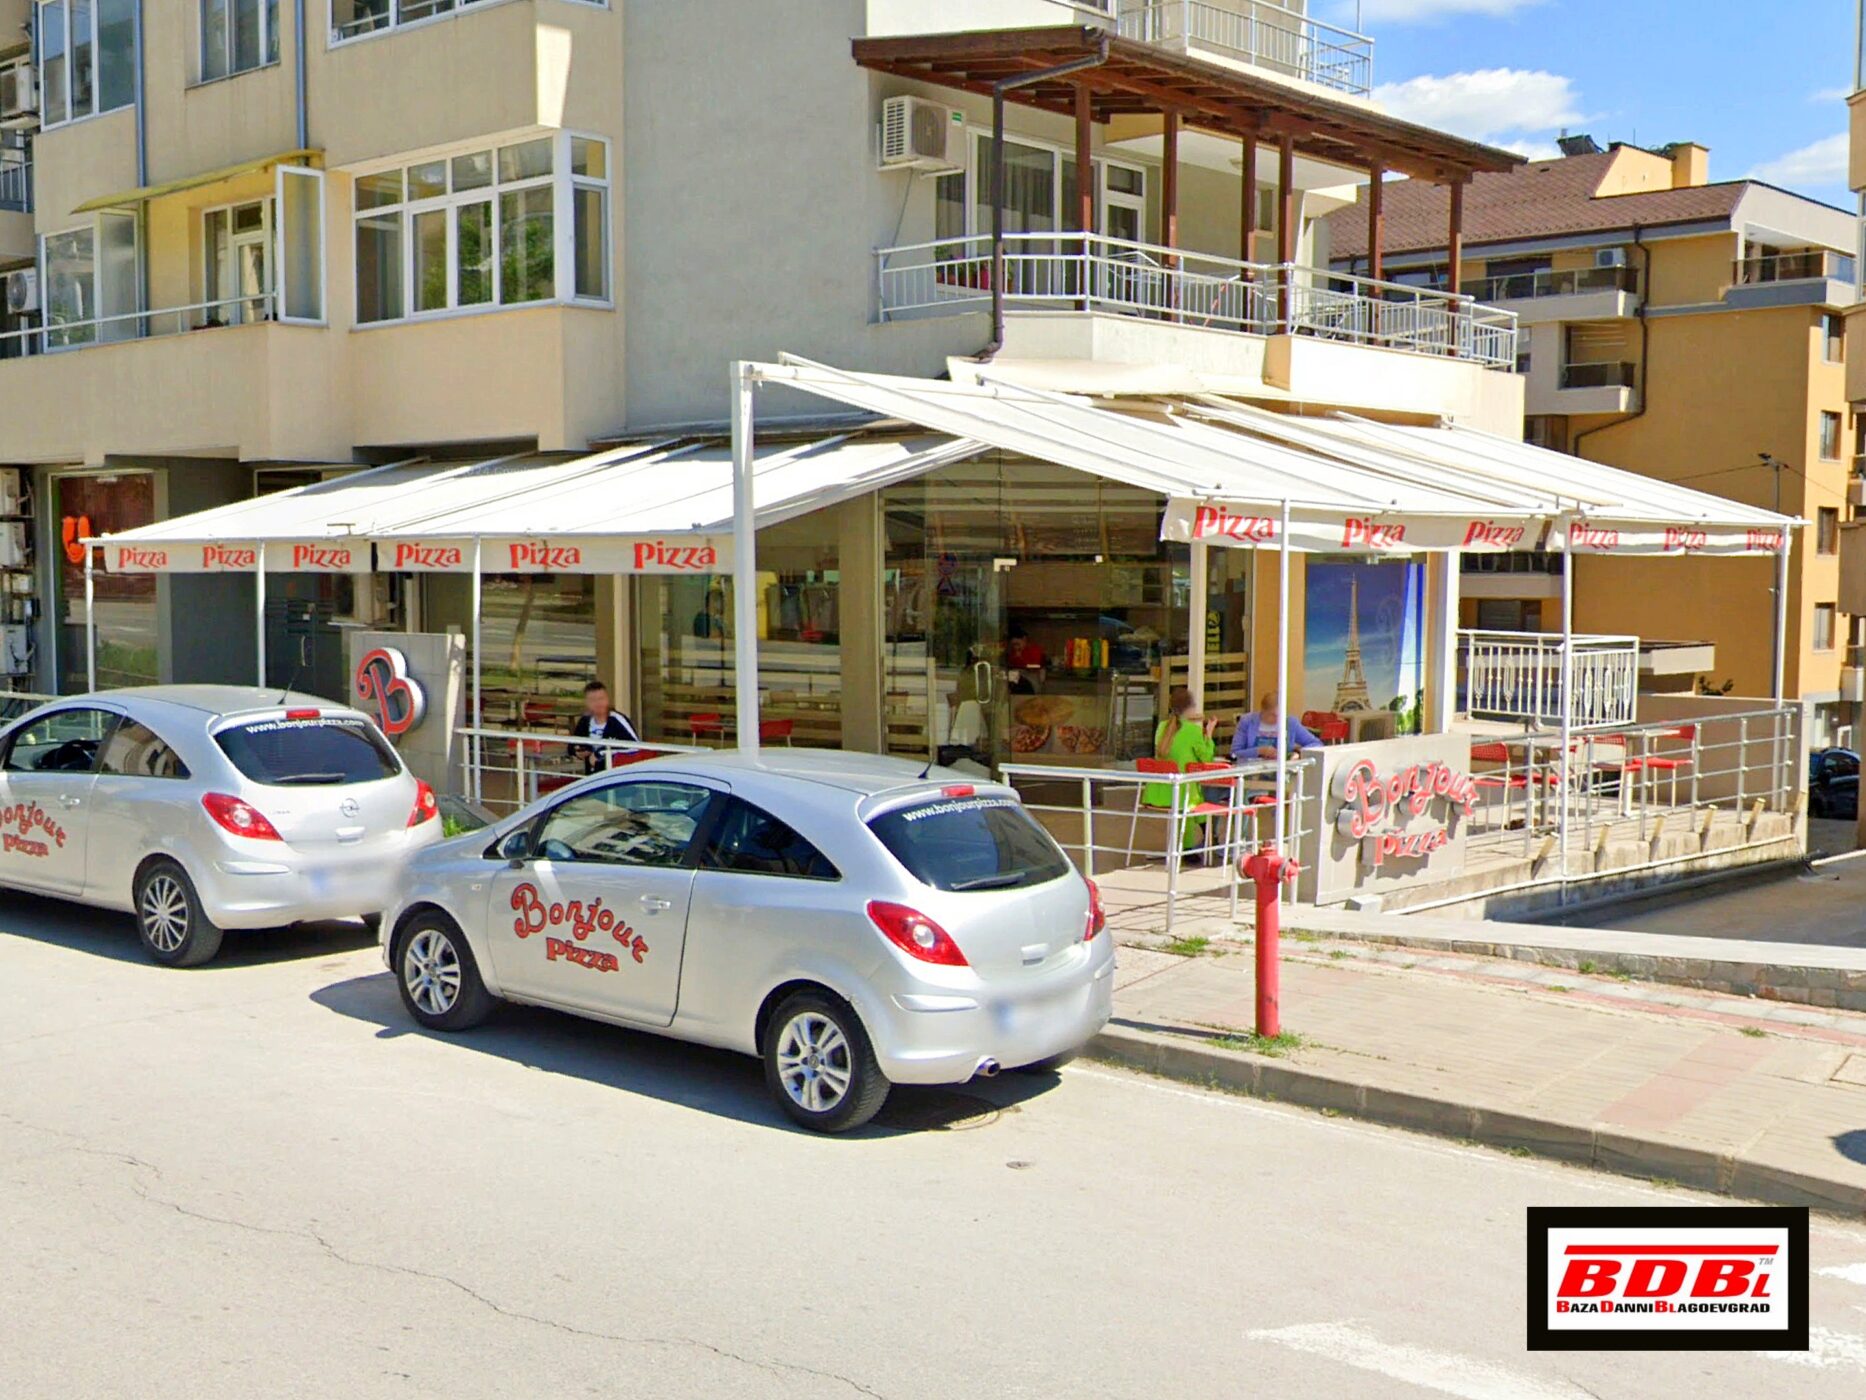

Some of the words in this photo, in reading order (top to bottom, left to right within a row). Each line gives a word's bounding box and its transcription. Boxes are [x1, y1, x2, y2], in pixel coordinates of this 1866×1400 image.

[1192, 505, 1274, 541] Pizza
[1341, 516, 1406, 547] Pizza
[1462, 519, 1526, 546] Pizza
[1570, 522, 1619, 549] Pizza
[118, 546, 168, 568] Pizza
[202, 544, 256, 568] Pizza
[293, 544, 351, 568] Pizza
[394, 542, 462, 568] Pizza
[509, 541, 581, 569] Pizza
[633, 541, 717, 569] Pizza
[0, 800, 66, 848] onjour
[511, 882, 649, 963] Bonjour
[546, 937, 619, 972] Pizza
